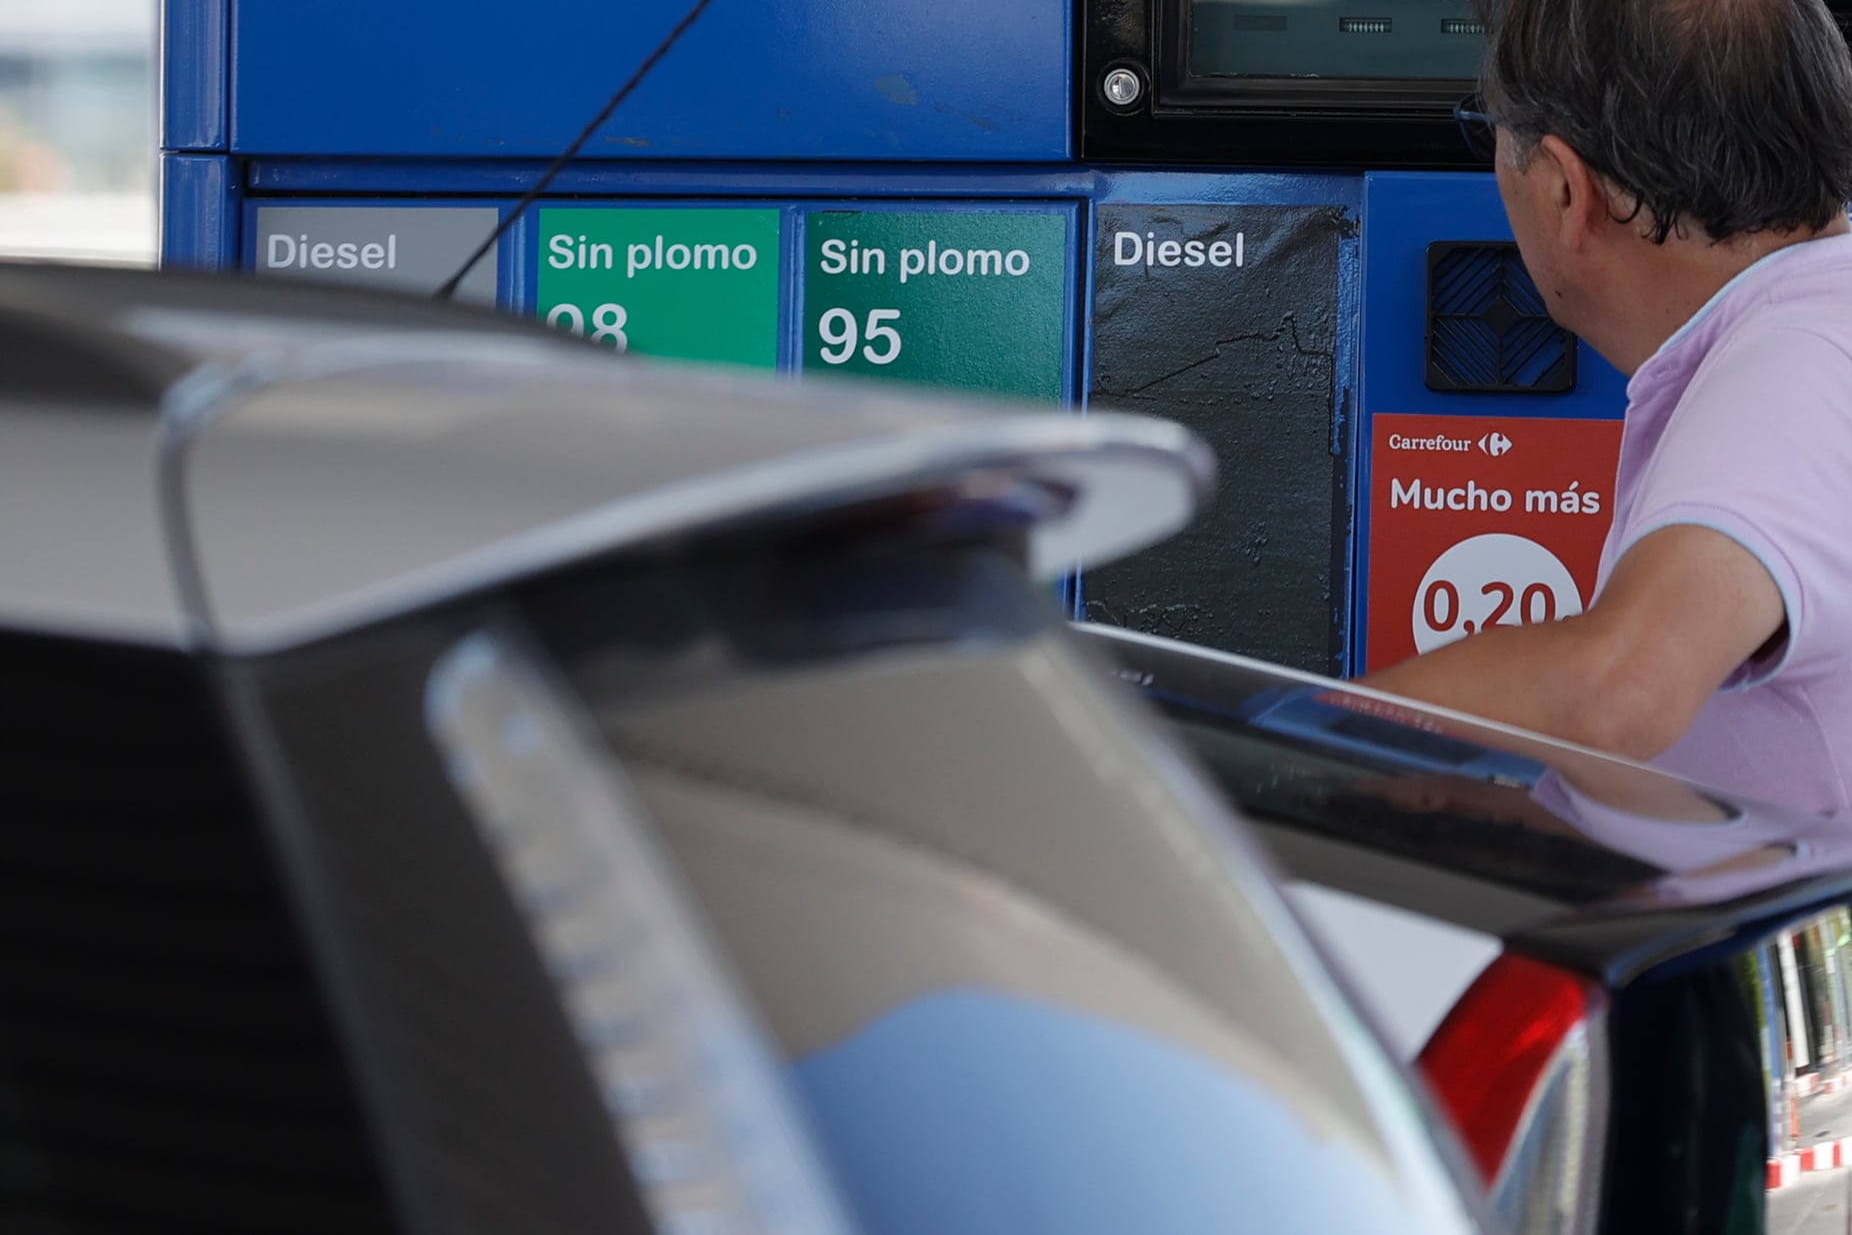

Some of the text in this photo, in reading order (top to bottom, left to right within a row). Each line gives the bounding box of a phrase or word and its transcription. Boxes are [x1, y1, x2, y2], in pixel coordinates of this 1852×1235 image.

[267, 233, 397, 270] Diesel
[548, 233, 759, 280] Sin plomo
[820, 239, 1031, 284] Sin plomo
[1113, 231, 1245, 268] Diesel
[818, 307, 902, 366] 95
[1388, 433, 1472, 452] Carrefour
[1390, 477, 1601, 515] Mucho más
